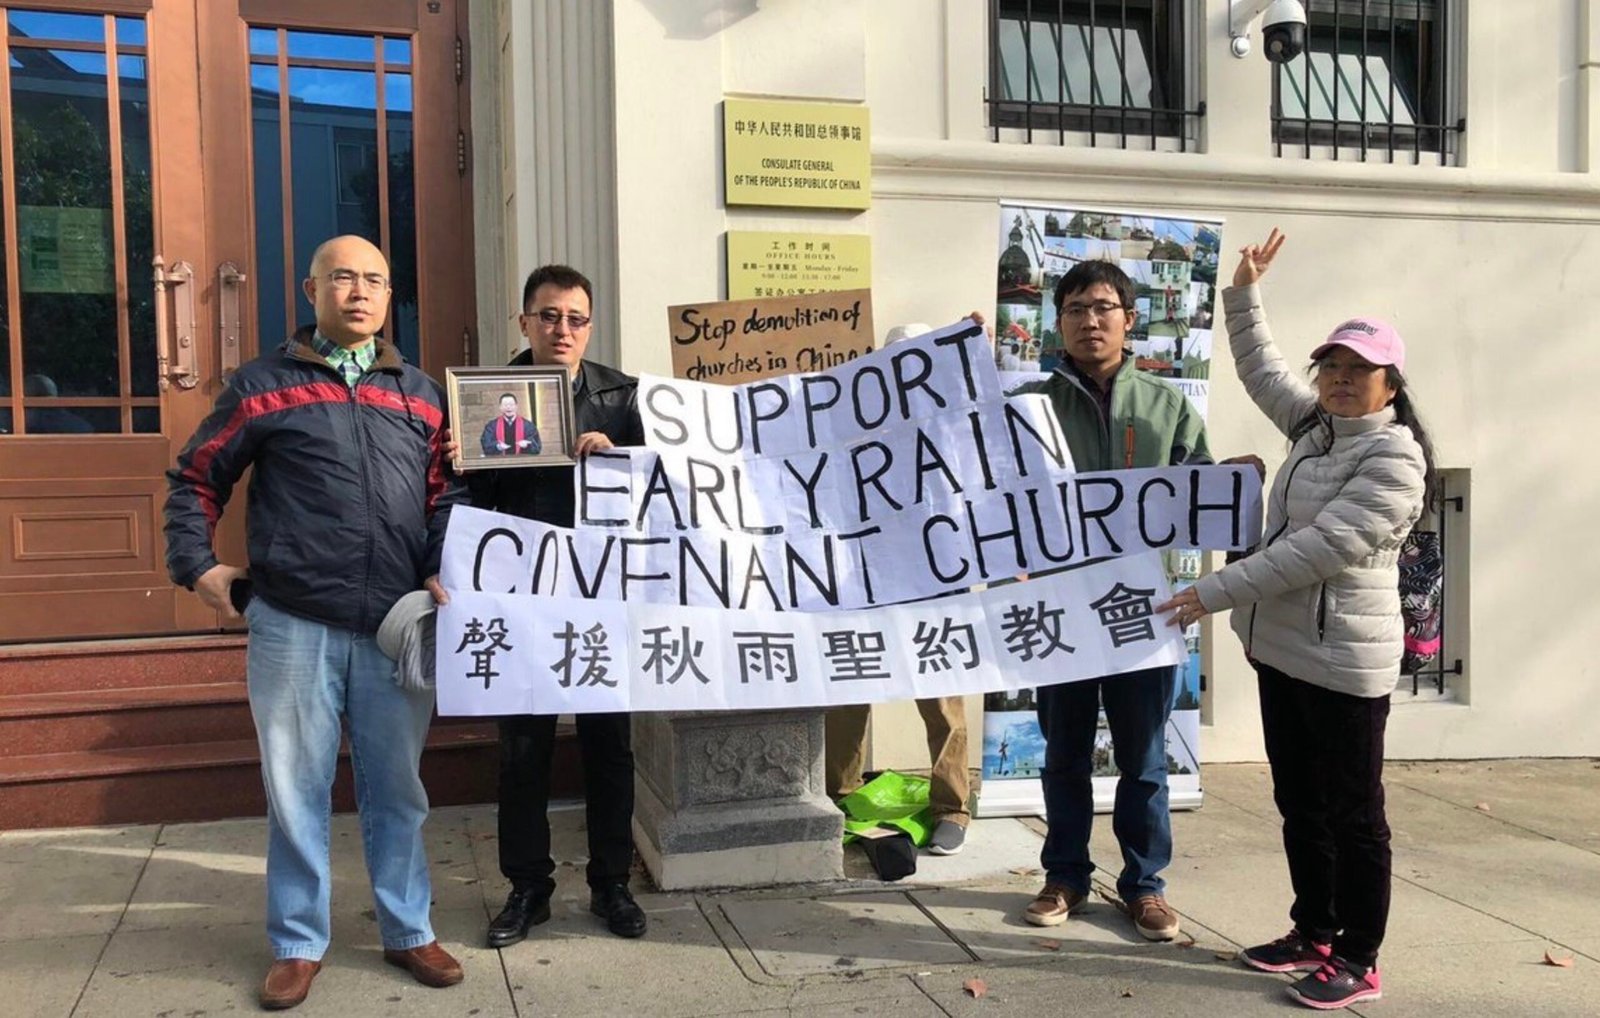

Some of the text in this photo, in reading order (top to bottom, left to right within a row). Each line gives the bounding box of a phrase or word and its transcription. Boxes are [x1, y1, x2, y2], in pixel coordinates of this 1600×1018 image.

[734, 119, 862, 141] 中华人民共和国总领事馆
[761, 158, 834, 172] CONSULATE GENERAL
[734, 174, 861, 190] OF THE PEOPLE'S REPUBLIC OF CHINA
[766, 252, 836, 261] OFFICE HOURS
[772, 242, 830, 252] 工作时间
[675, 300, 861, 351] Stop demolition of
[686, 353, 762, 382] churches
[766, 350, 788, 371] in
[645, 325, 982, 454] SUPPORT
[579, 398, 1066, 535] EARLY RAIN
[473, 469, 1242, 611] COVENANT CHURCH
[455, 582, 1157, 690] 聲援秋雨聖約教會
